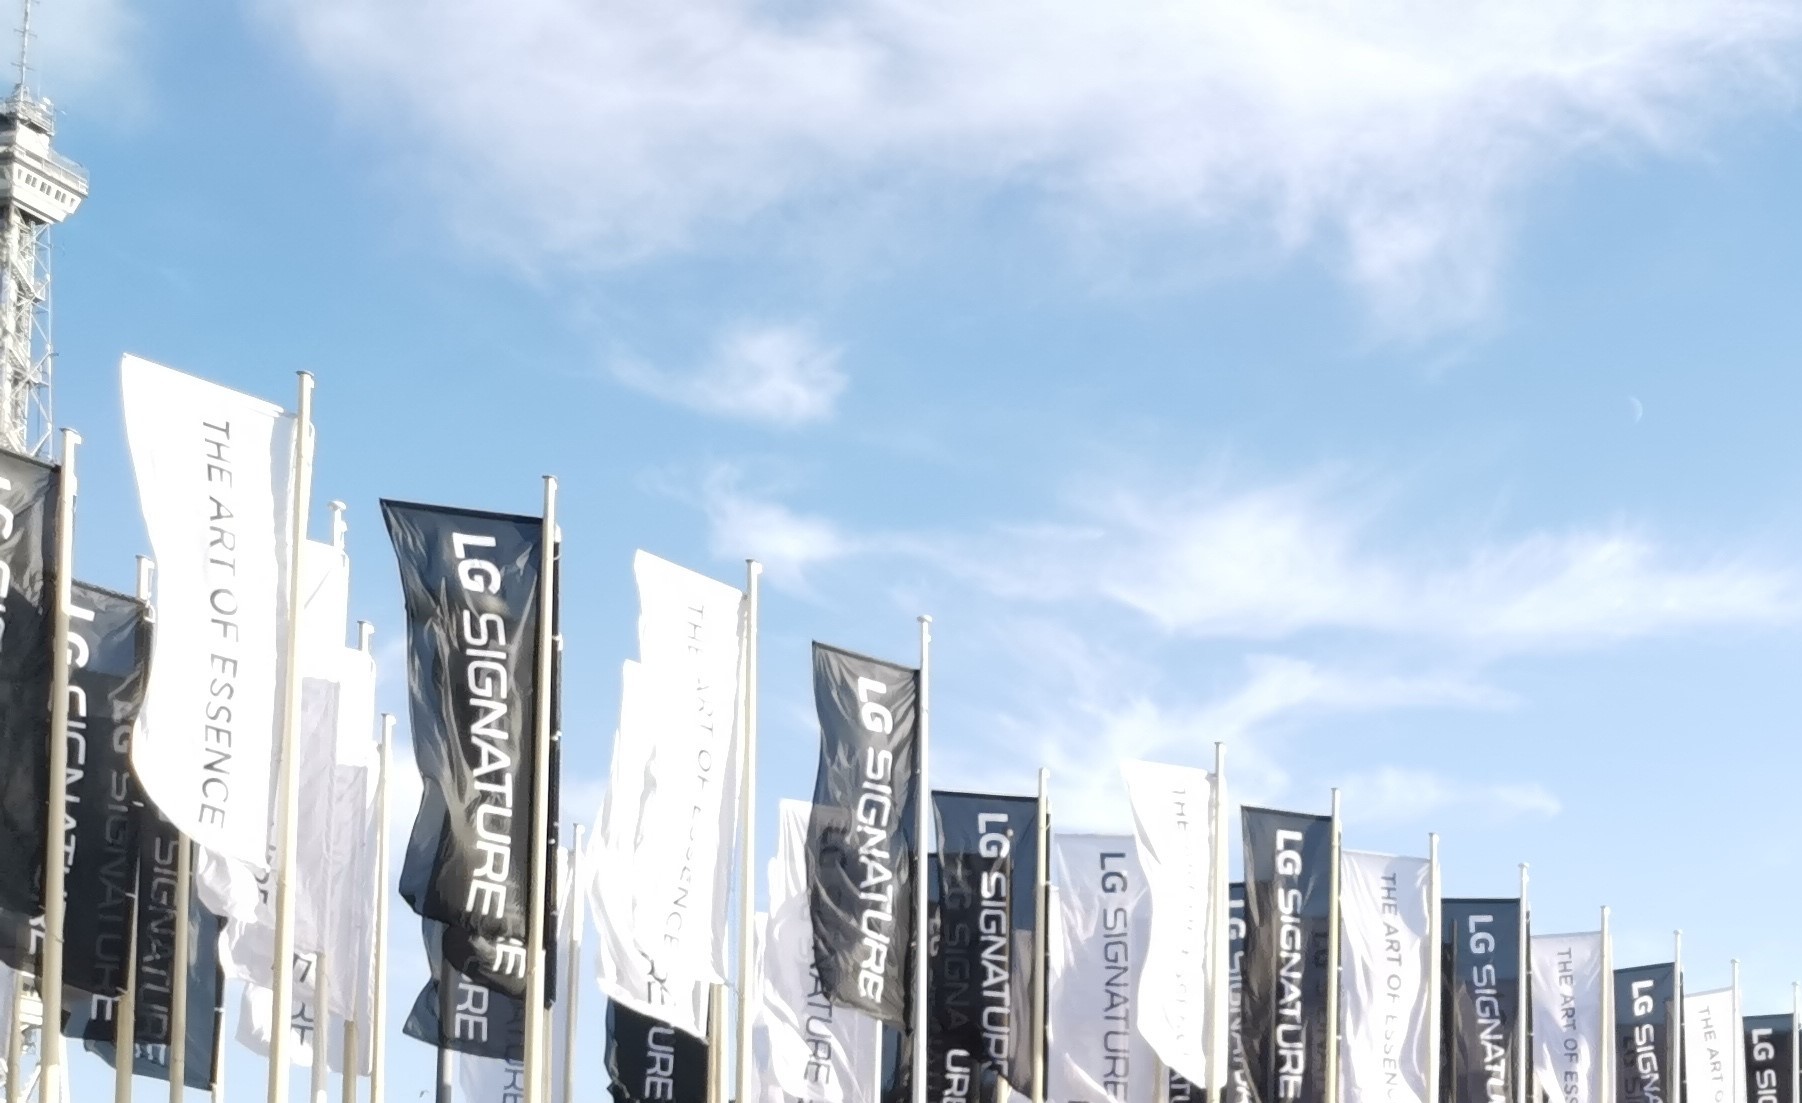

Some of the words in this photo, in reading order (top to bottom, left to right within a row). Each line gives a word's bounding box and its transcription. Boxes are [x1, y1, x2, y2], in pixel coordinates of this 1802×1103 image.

[203, 421, 233, 488] THE
[208, 496, 237, 577] ART
[452, 531, 501, 595] LG
[209, 588, 239, 643] OF
[856, 676, 893, 735] LG
[198, 653, 239, 829] ESSENCE
[462, 609, 513, 922] SIGNATURE
[977, 811, 1011, 860] LG
[1276, 829, 1303, 877] LG
[856, 746, 893, 1004] SIGNATURE
[1099, 851, 1128, 894] LG
[1380, 872, 1398, 916] THE
[1382, 921, 1402, 967] ART
[1467, 914, 1495, 955] LG
[1275, 887, 1305, 1099] SIGNATURE
[1556, 947, 1573, 987] THE
[1102, 906, 1131, 1102] SIGNATURE
[1558, 995, 1576, 1032] ART
[1631, 979, 1655, 1017] LG
[1563, 1037, 1578, 1064] OF
[1697, 1005, 1714, 1041] THE
[1706, 1046, 1724, 1085] ART
[1751, 1027, 1774, 1061] LG
